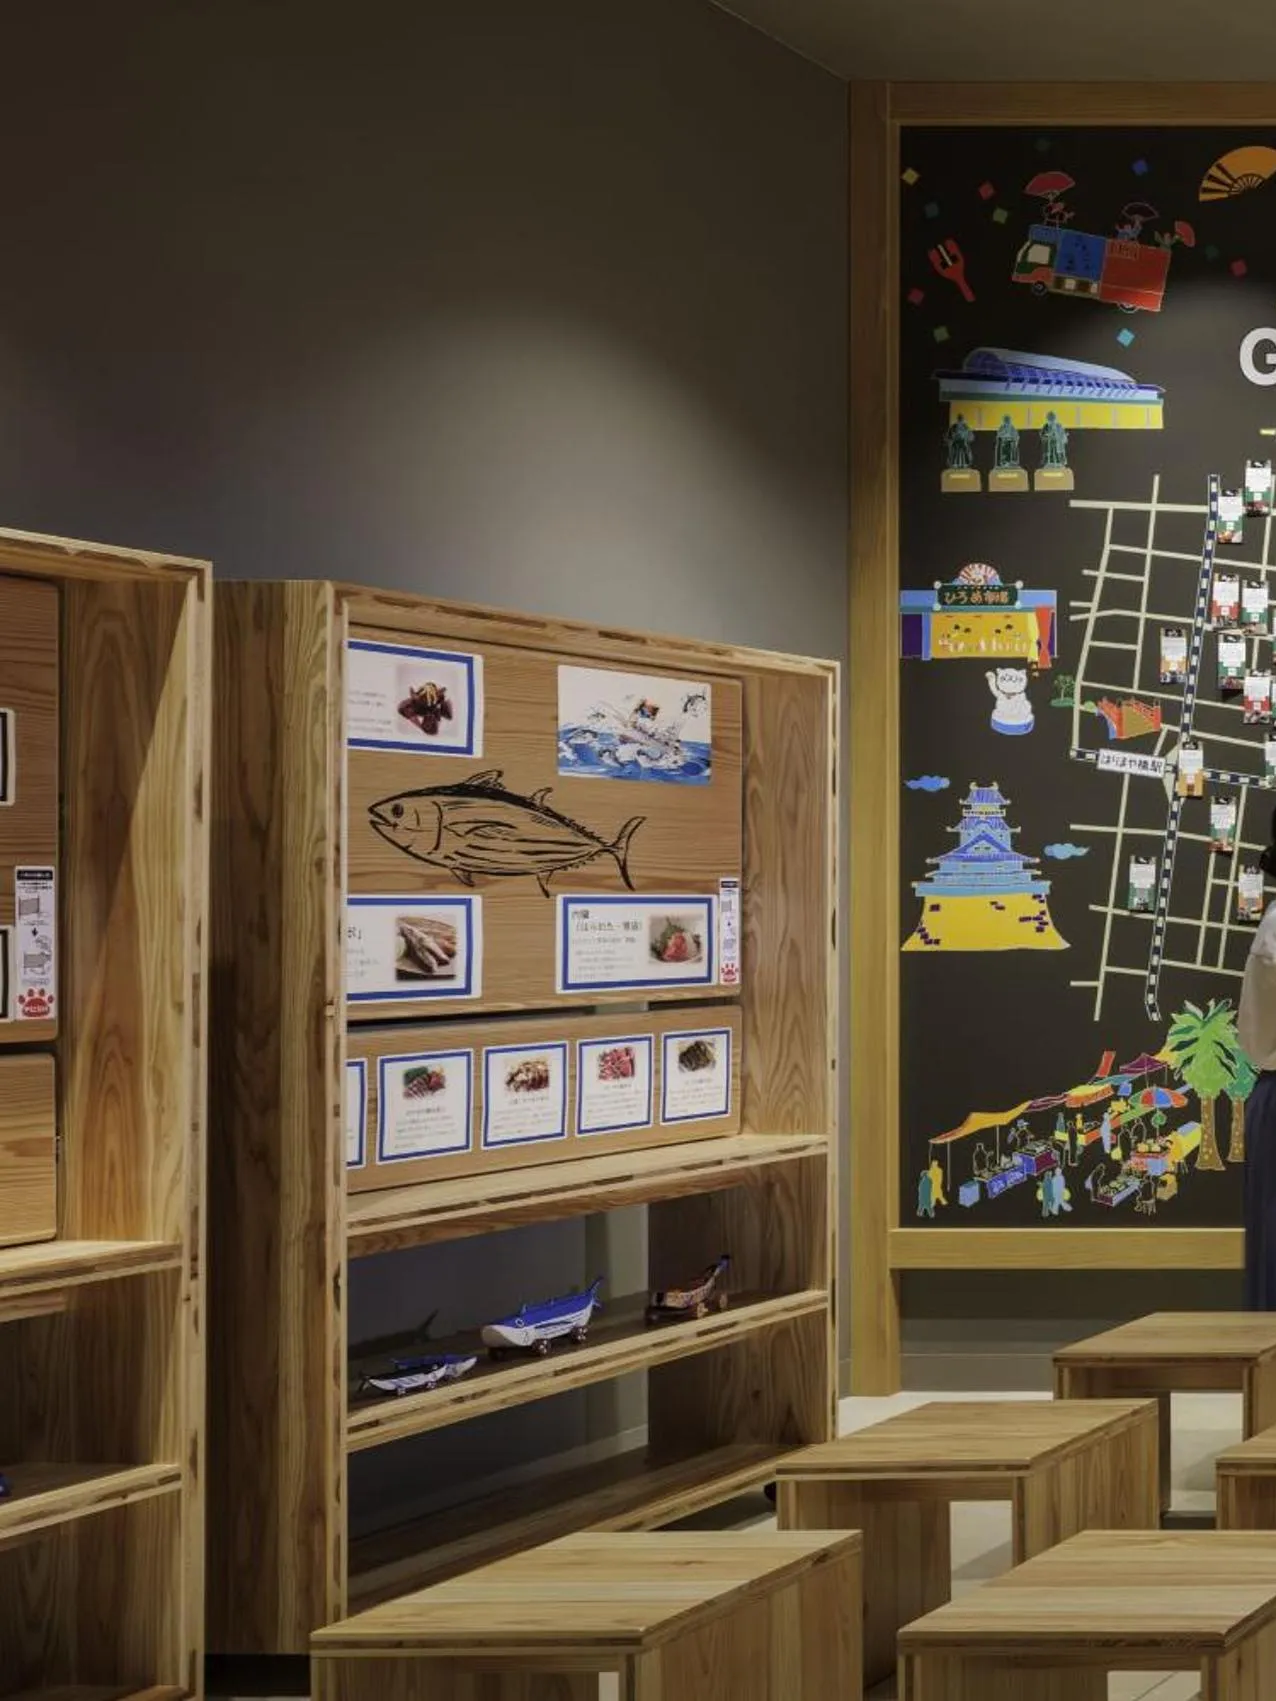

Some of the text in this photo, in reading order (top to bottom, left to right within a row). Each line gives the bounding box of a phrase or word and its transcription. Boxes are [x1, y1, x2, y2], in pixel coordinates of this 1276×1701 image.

[1102, 754, 1163, 773] はりまや橋駅
